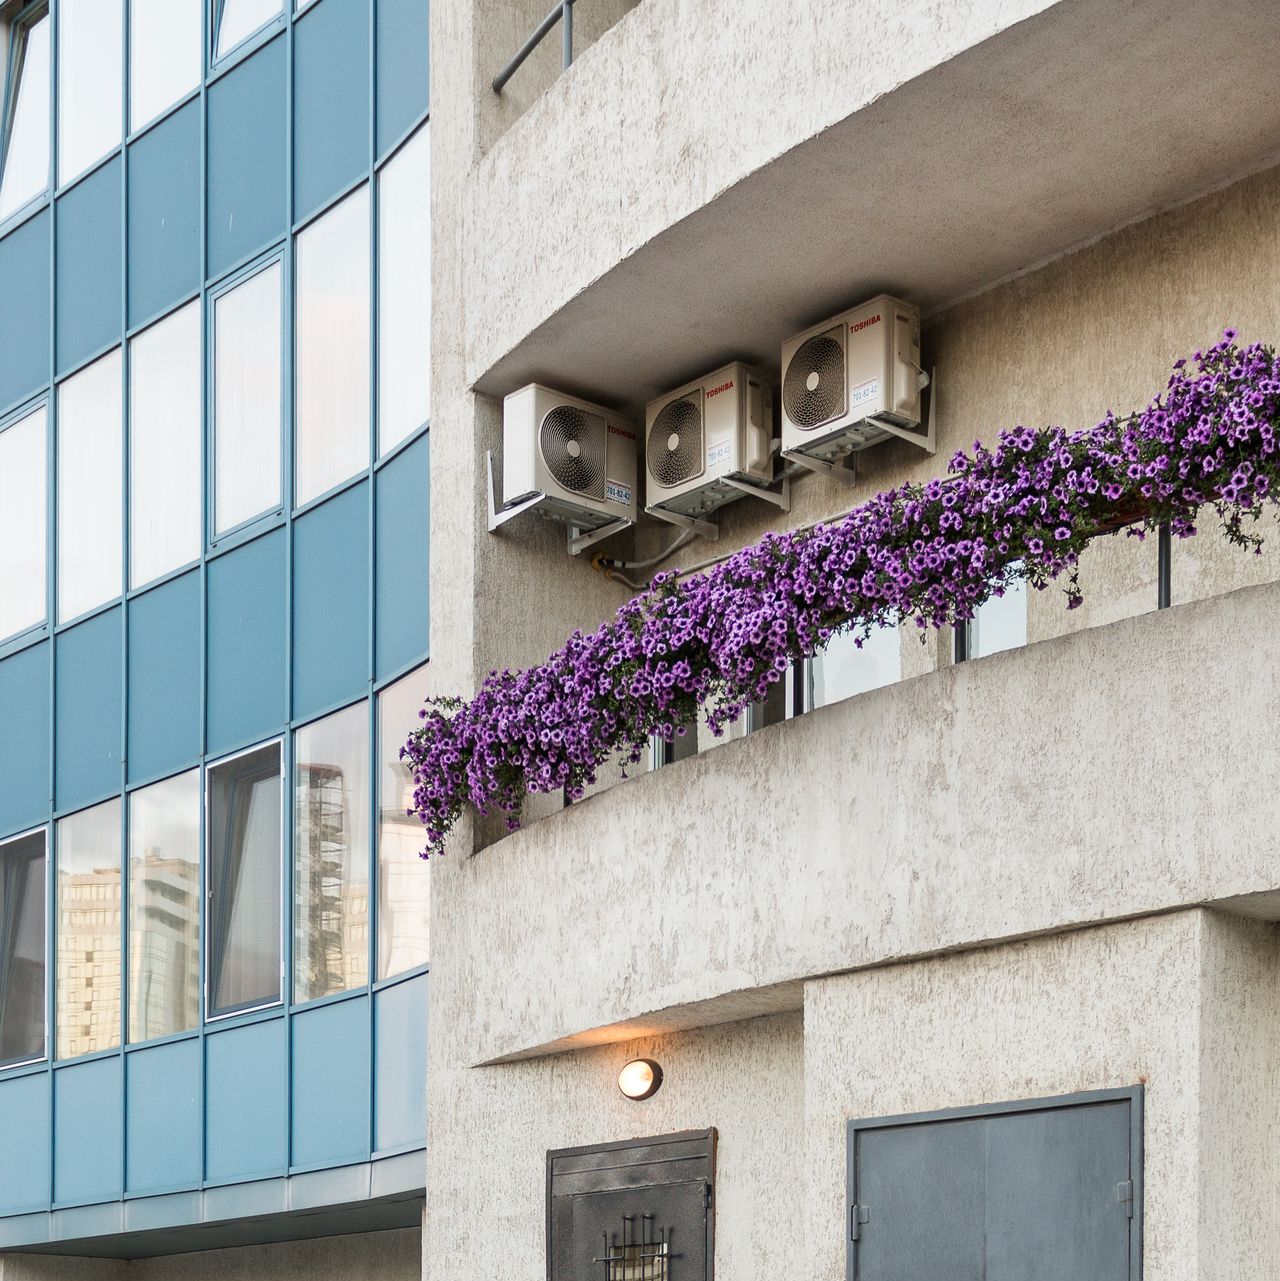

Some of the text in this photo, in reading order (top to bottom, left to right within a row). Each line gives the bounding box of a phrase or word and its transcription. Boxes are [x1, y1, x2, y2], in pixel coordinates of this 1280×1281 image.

[849, 314, 881, 334] TOSHIBA
[706, 381, 734, 399] TOSHIBA
[607, 424, 636, 440] TOSHIBA
